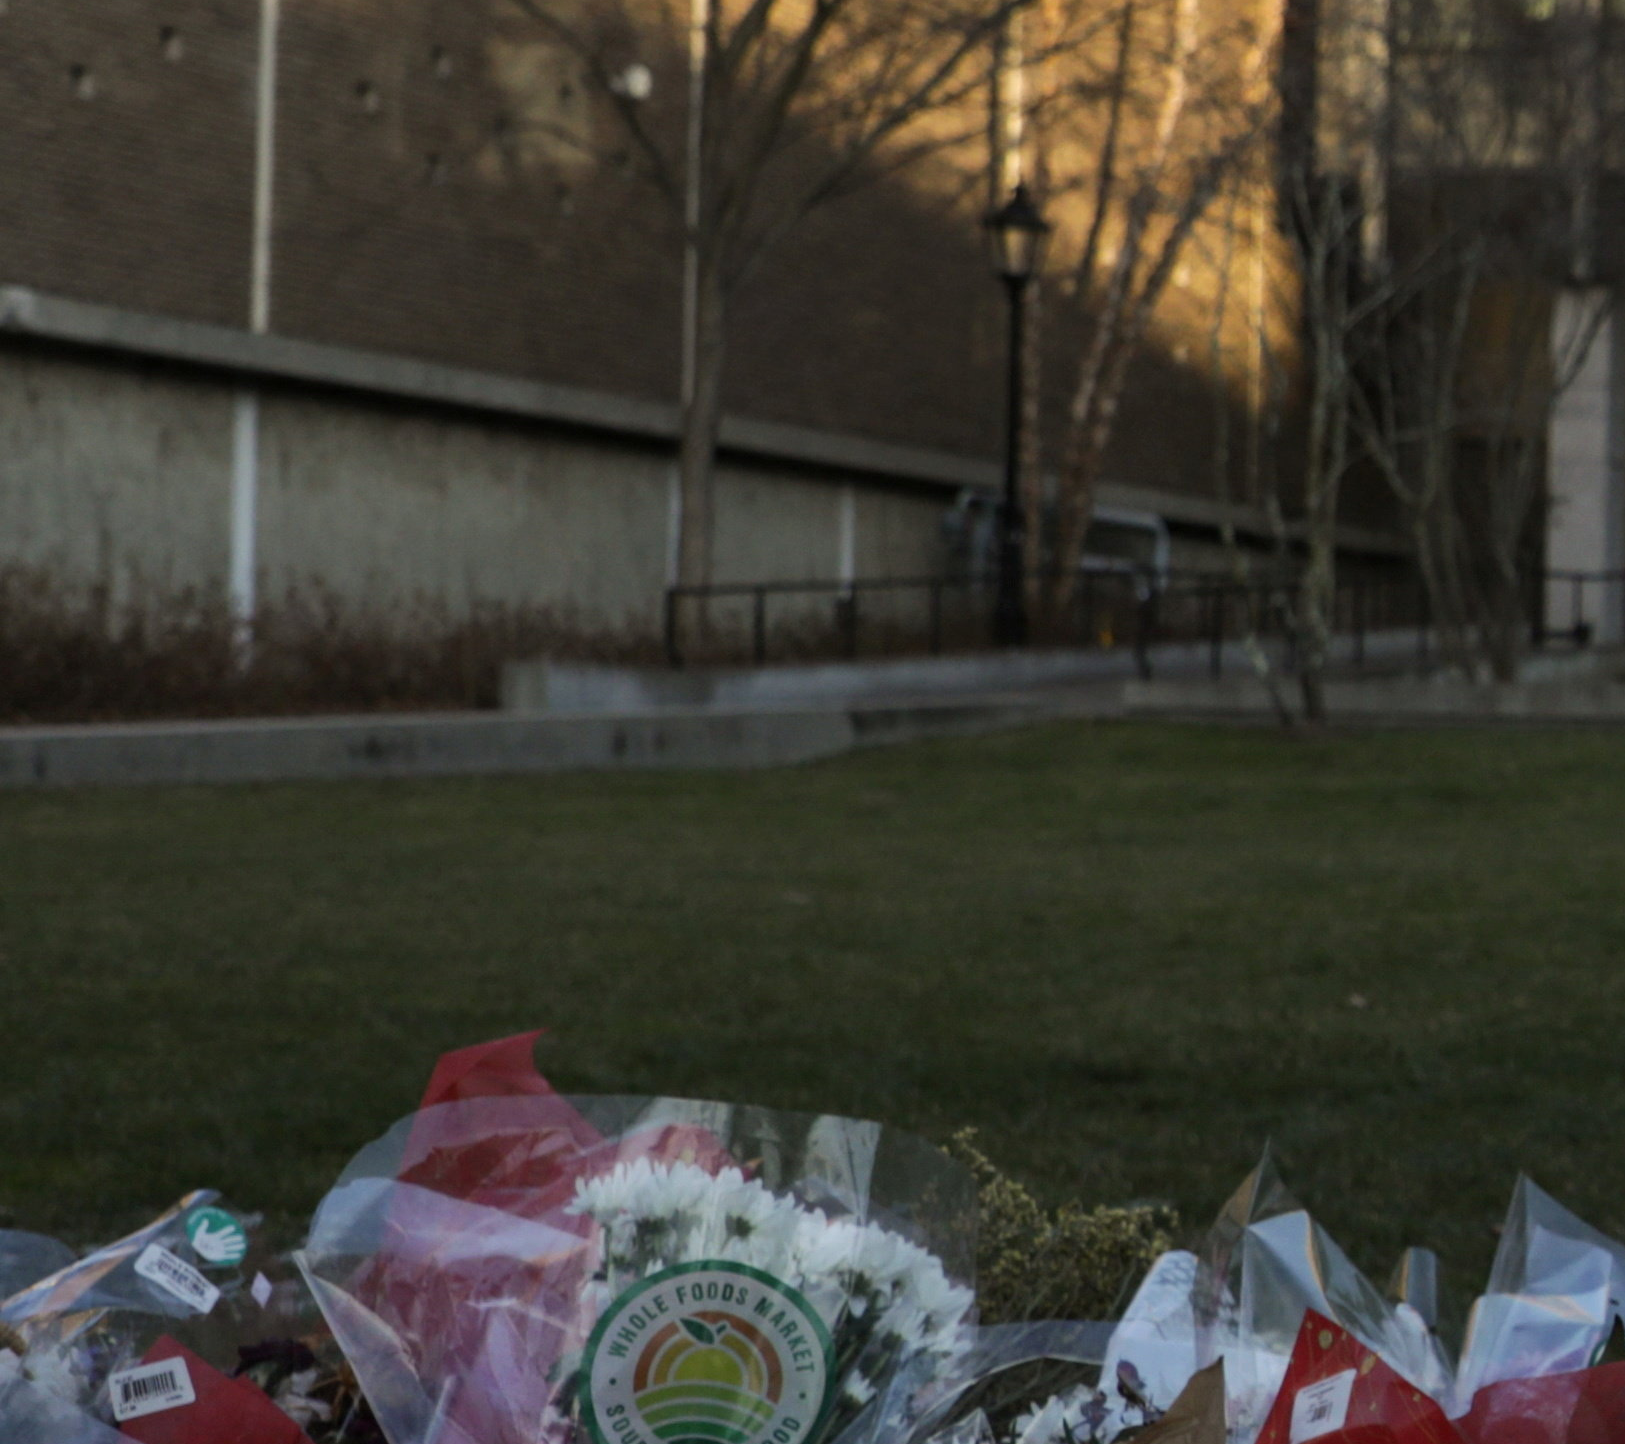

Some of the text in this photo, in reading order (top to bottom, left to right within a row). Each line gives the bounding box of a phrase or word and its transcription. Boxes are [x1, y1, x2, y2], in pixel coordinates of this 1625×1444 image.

[608, 1282, 814, 1372] WHOLE FOODS MARKET
